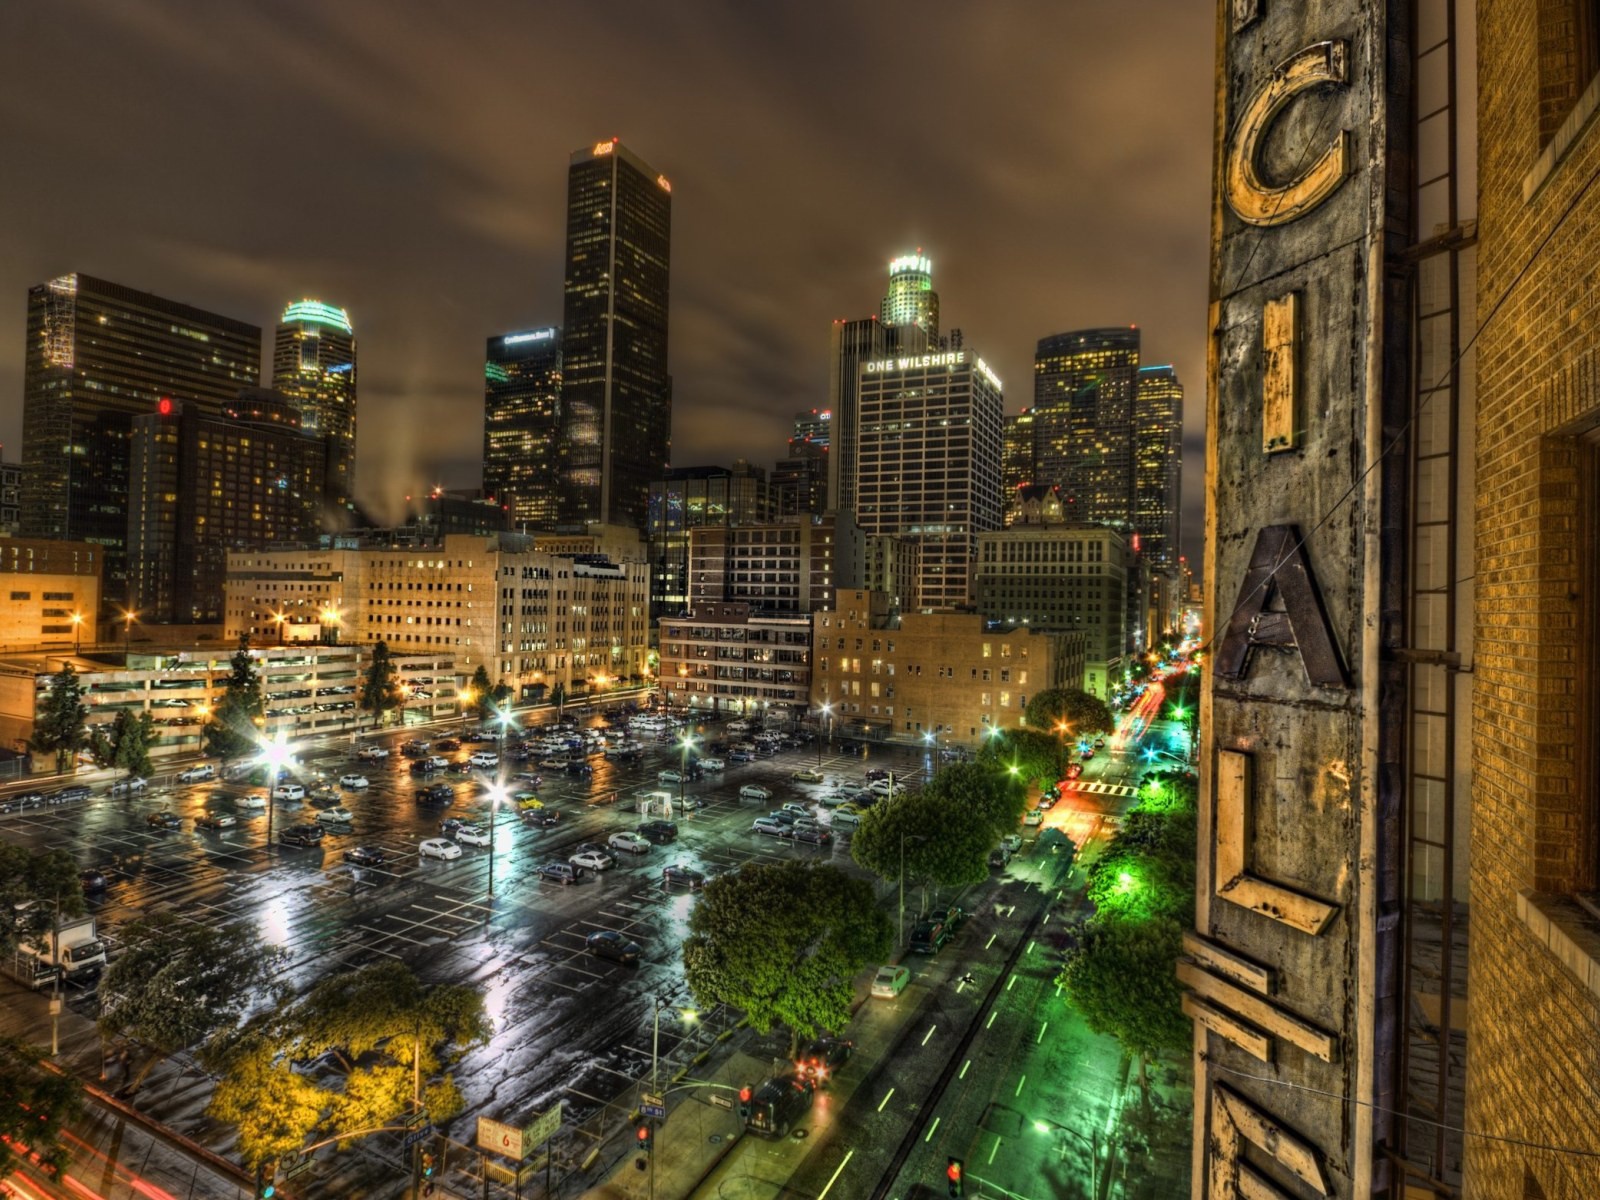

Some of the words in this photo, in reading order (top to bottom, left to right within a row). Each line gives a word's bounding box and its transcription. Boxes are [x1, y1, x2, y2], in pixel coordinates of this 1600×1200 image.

[867, 360, 894, 373] ONE
[898, 351, 965, 370] WILSHIRE
[1212, 0, 1351, 936] CIAL
